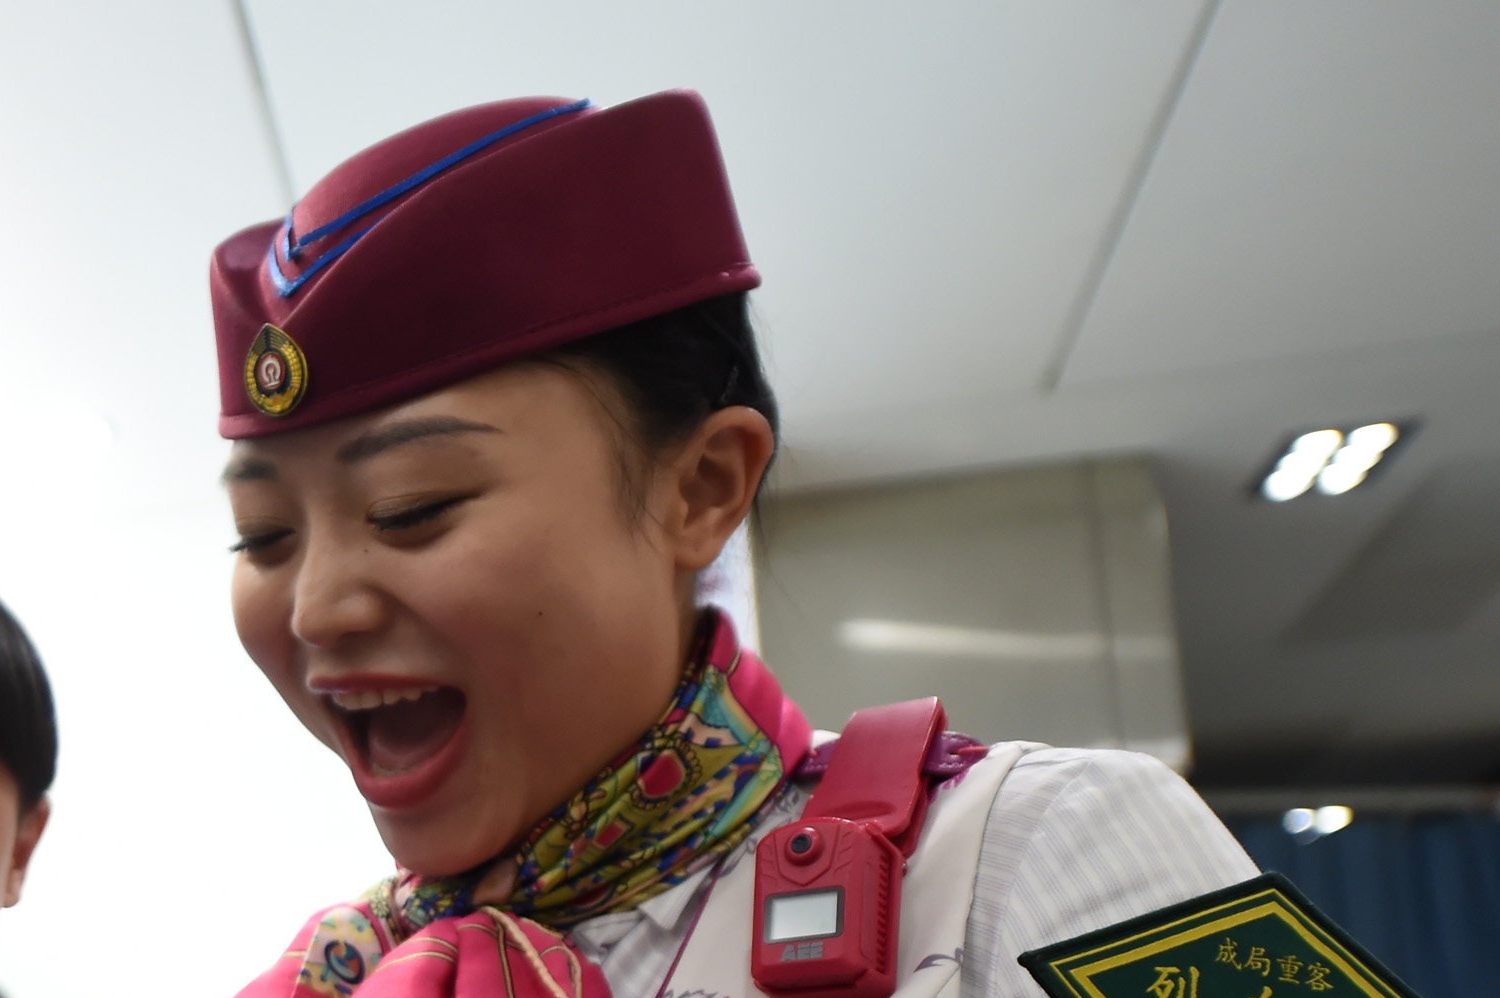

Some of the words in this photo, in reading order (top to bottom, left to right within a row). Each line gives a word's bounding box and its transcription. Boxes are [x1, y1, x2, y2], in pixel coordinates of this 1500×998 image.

[780, 941, 824, 962] AEE
[1215, 937, 1335, 993] 成局重客
